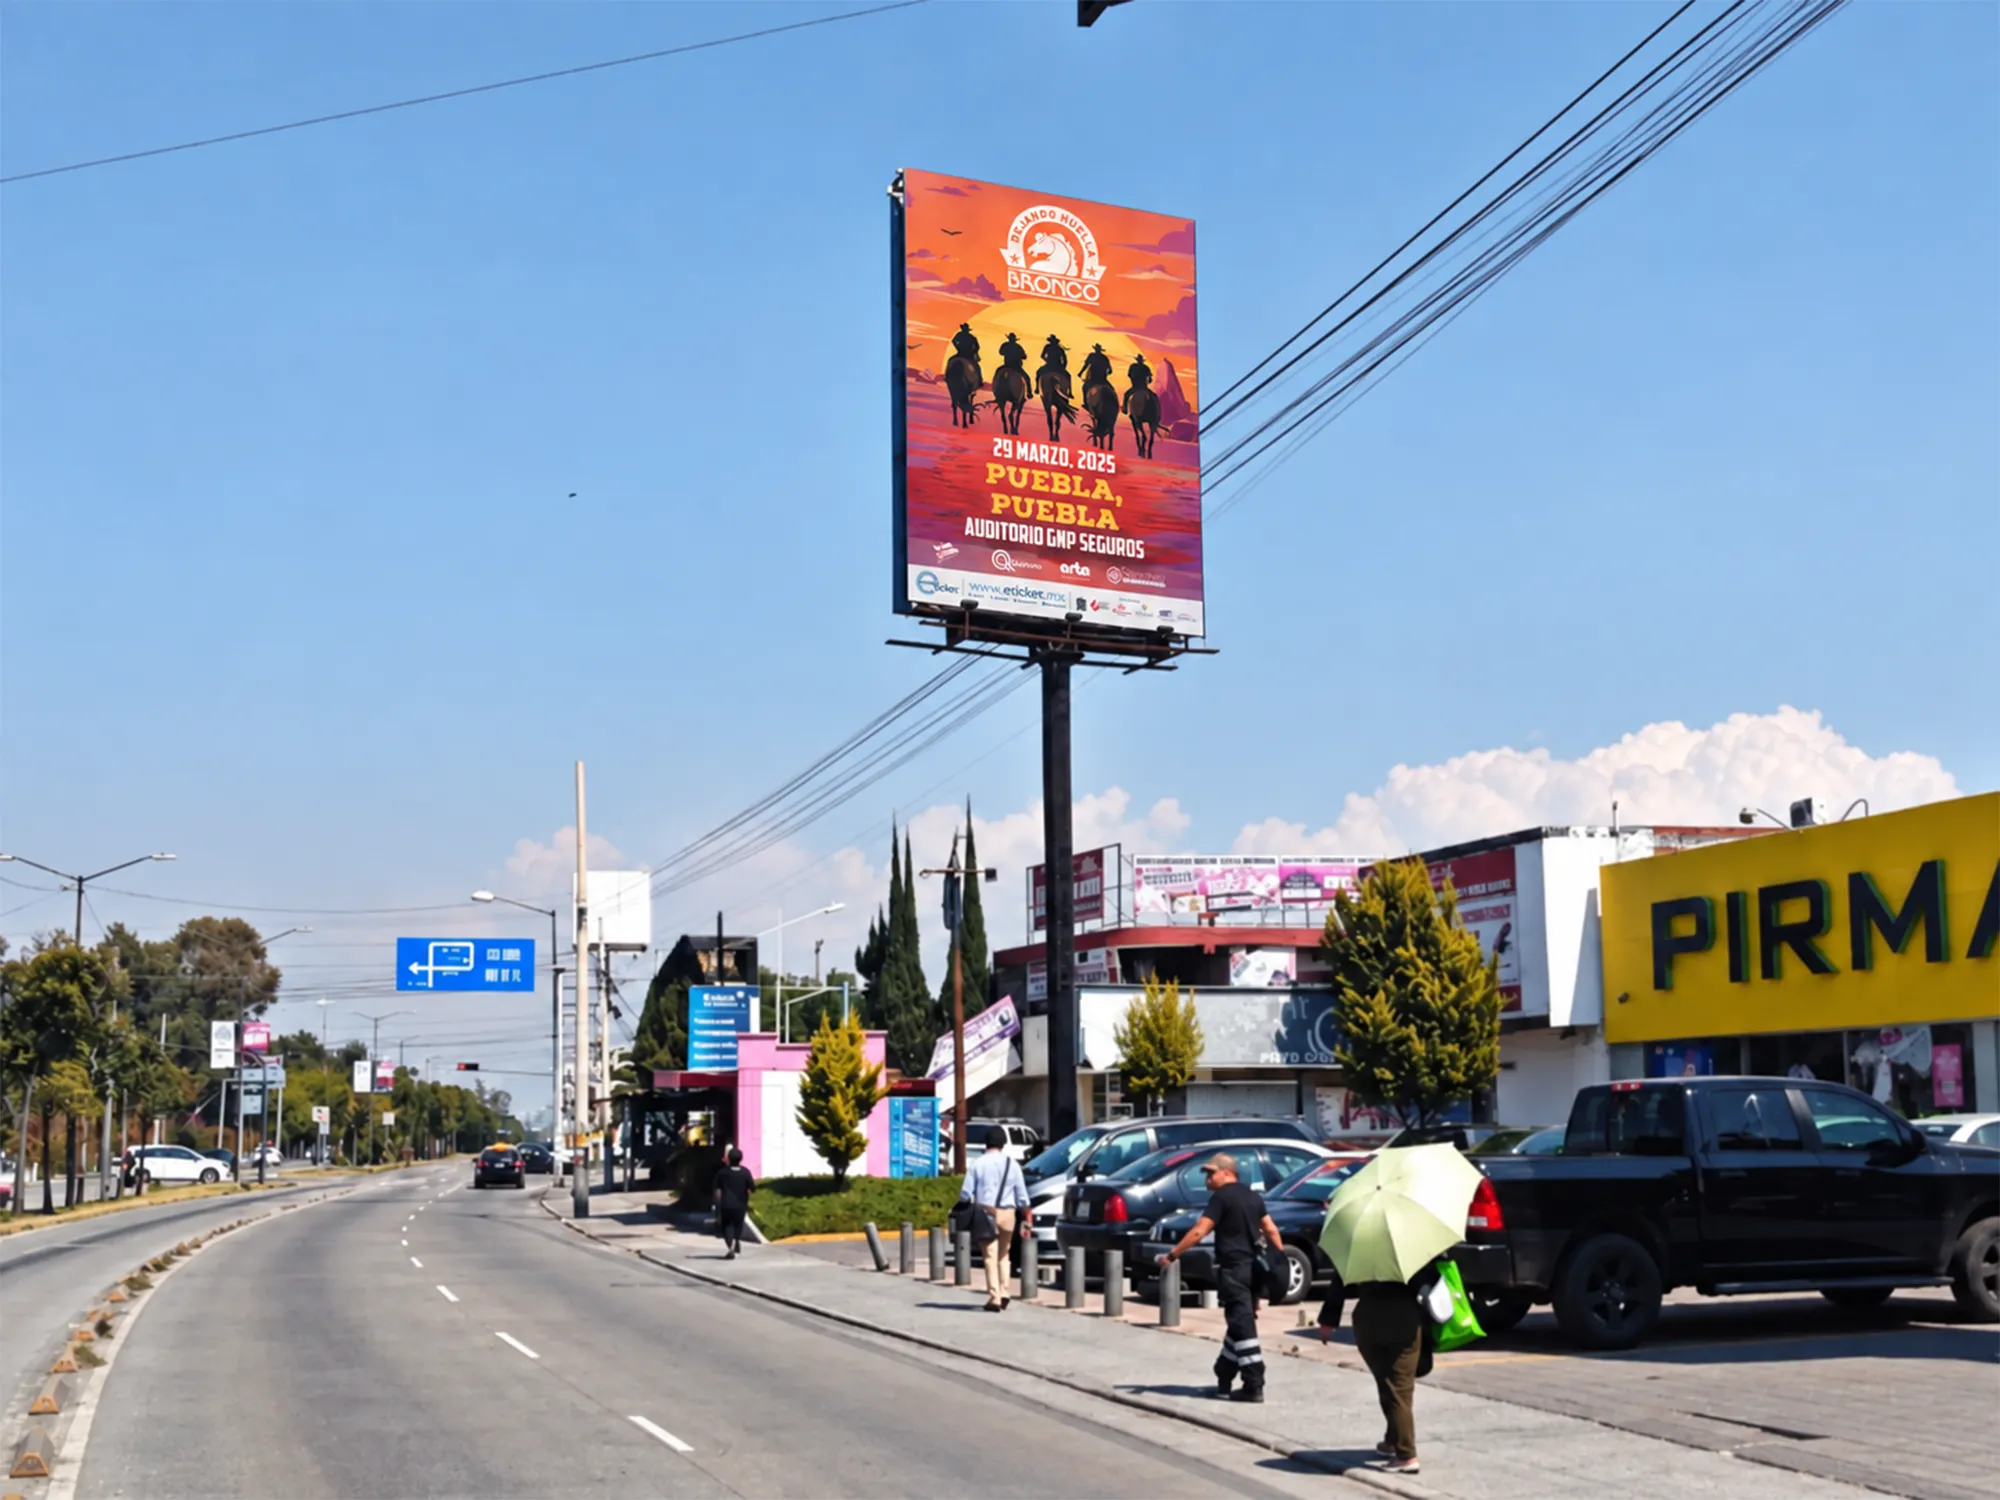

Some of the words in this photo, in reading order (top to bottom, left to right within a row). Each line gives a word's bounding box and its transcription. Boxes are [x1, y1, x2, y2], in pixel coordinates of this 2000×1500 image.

[1010, 209, 1057, 244] DEJANDO
[1060, 212, 1097, 259] HUELLA
[1007, 270, 1100, 302] BRONCO
[993, 437, 1013, 459] 29
[1077, 449, 1116, 474] 2025
[985, 461, 1124, 508] PUEBLA,
[990, 492, 1120, 531] PUEBLA
[964, 516, 1043, 547] AUDITORIO
[1046, 527, 1077, 552] GNP
[1079, 531, 1145, 560] SEGUROS
[1059, 561, 1091, 577] arta
[968, 581, 1066, 603] www.eticket.mx
